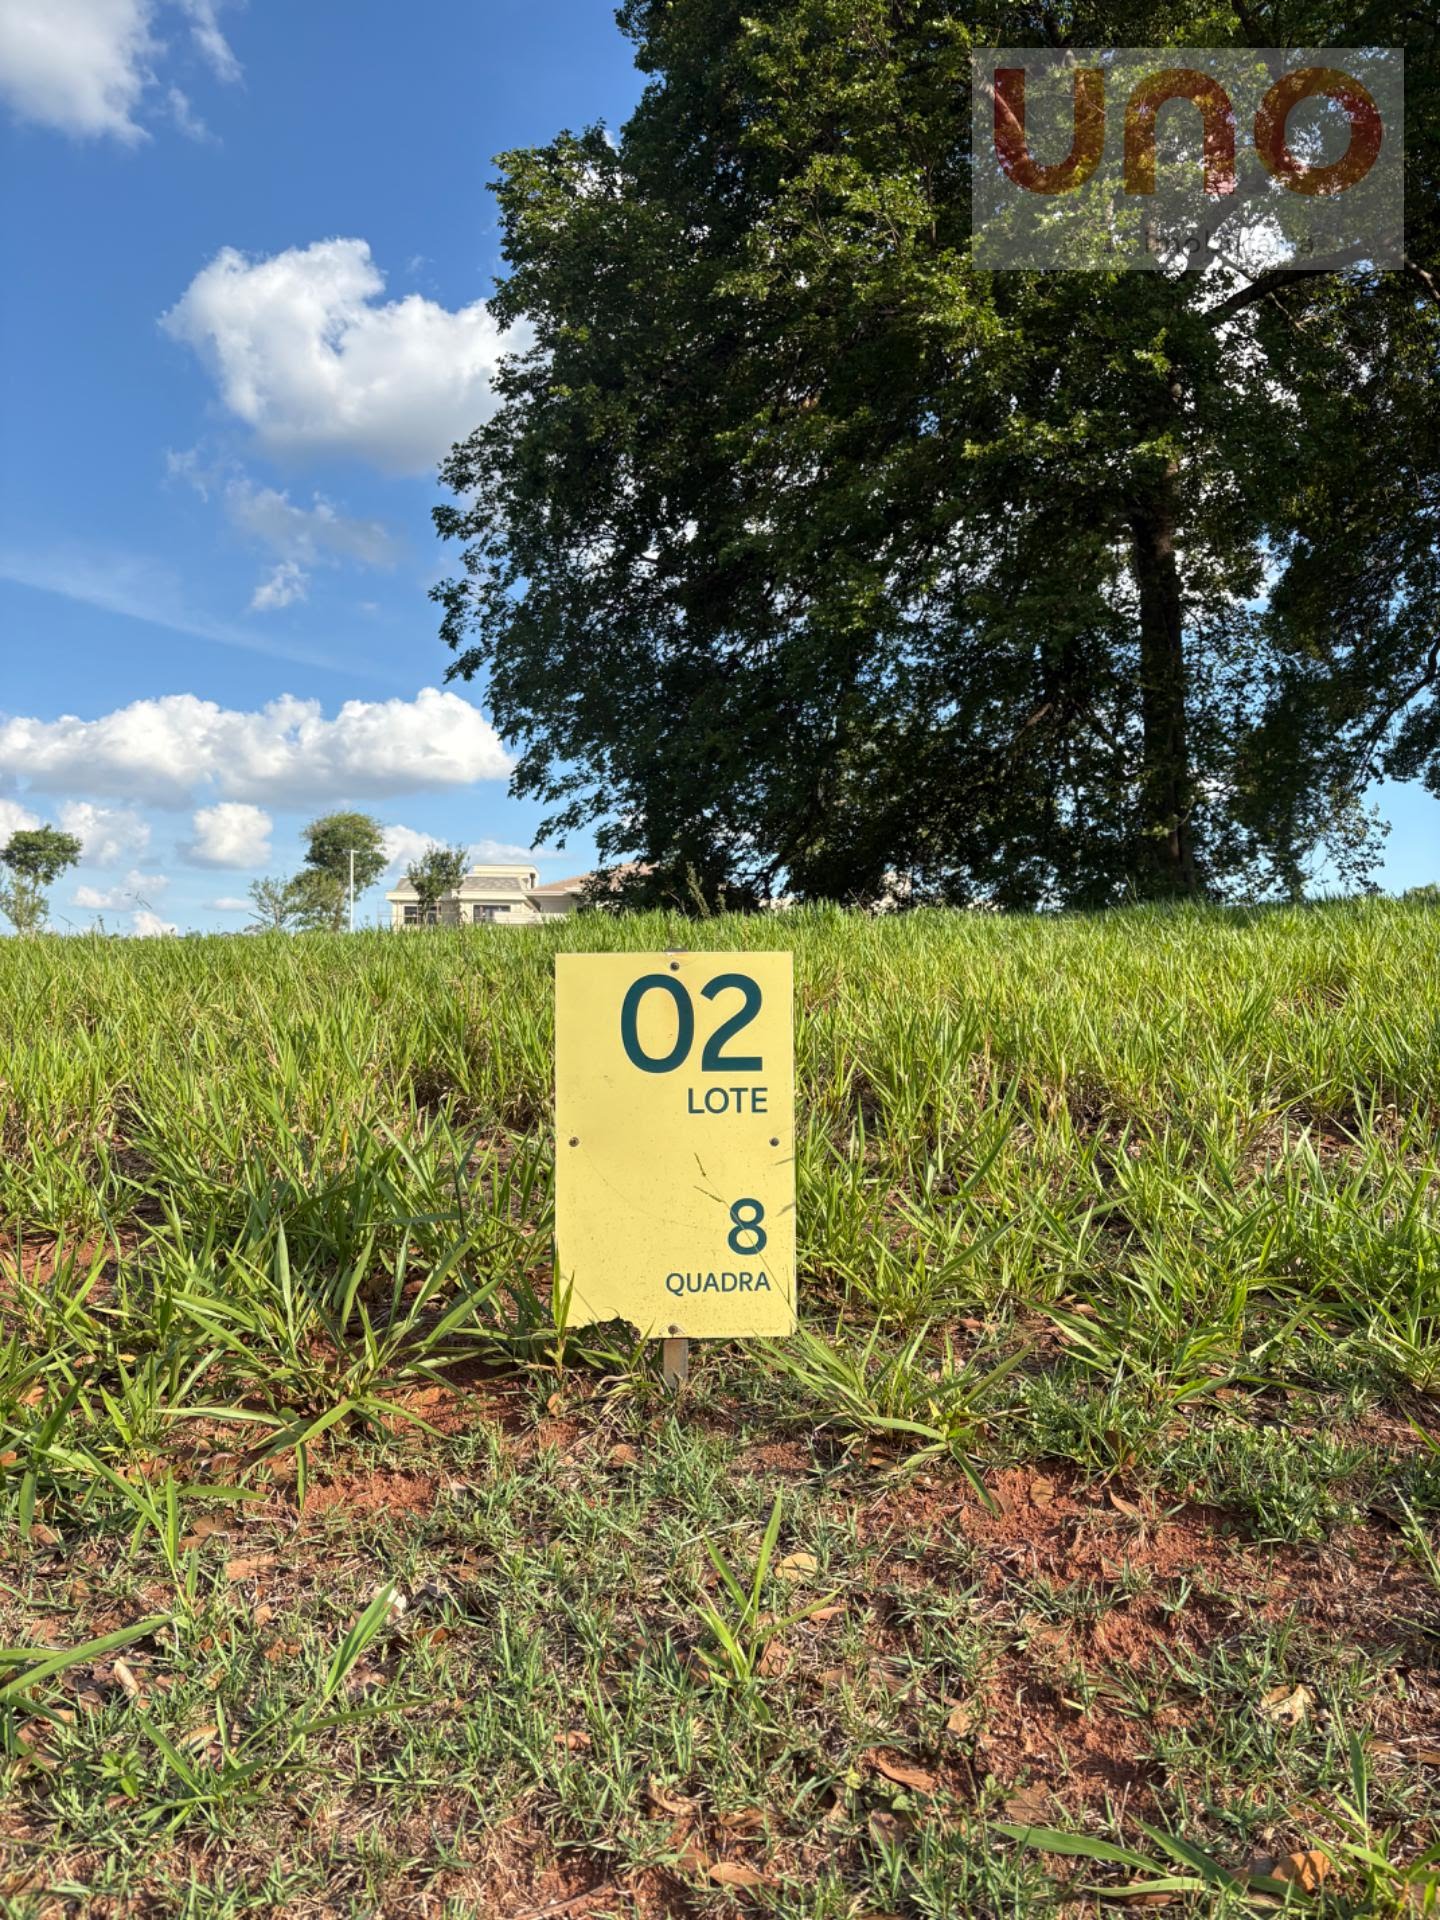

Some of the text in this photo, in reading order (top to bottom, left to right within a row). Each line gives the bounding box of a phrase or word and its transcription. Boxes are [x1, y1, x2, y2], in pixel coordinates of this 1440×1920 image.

[620, 973, 763, 1074] 02
[687, 1086, 768, 1115] LOTE
[727, 1197, 768, 1256] 8
[665, 1271, 771, 1297] QUADRA
